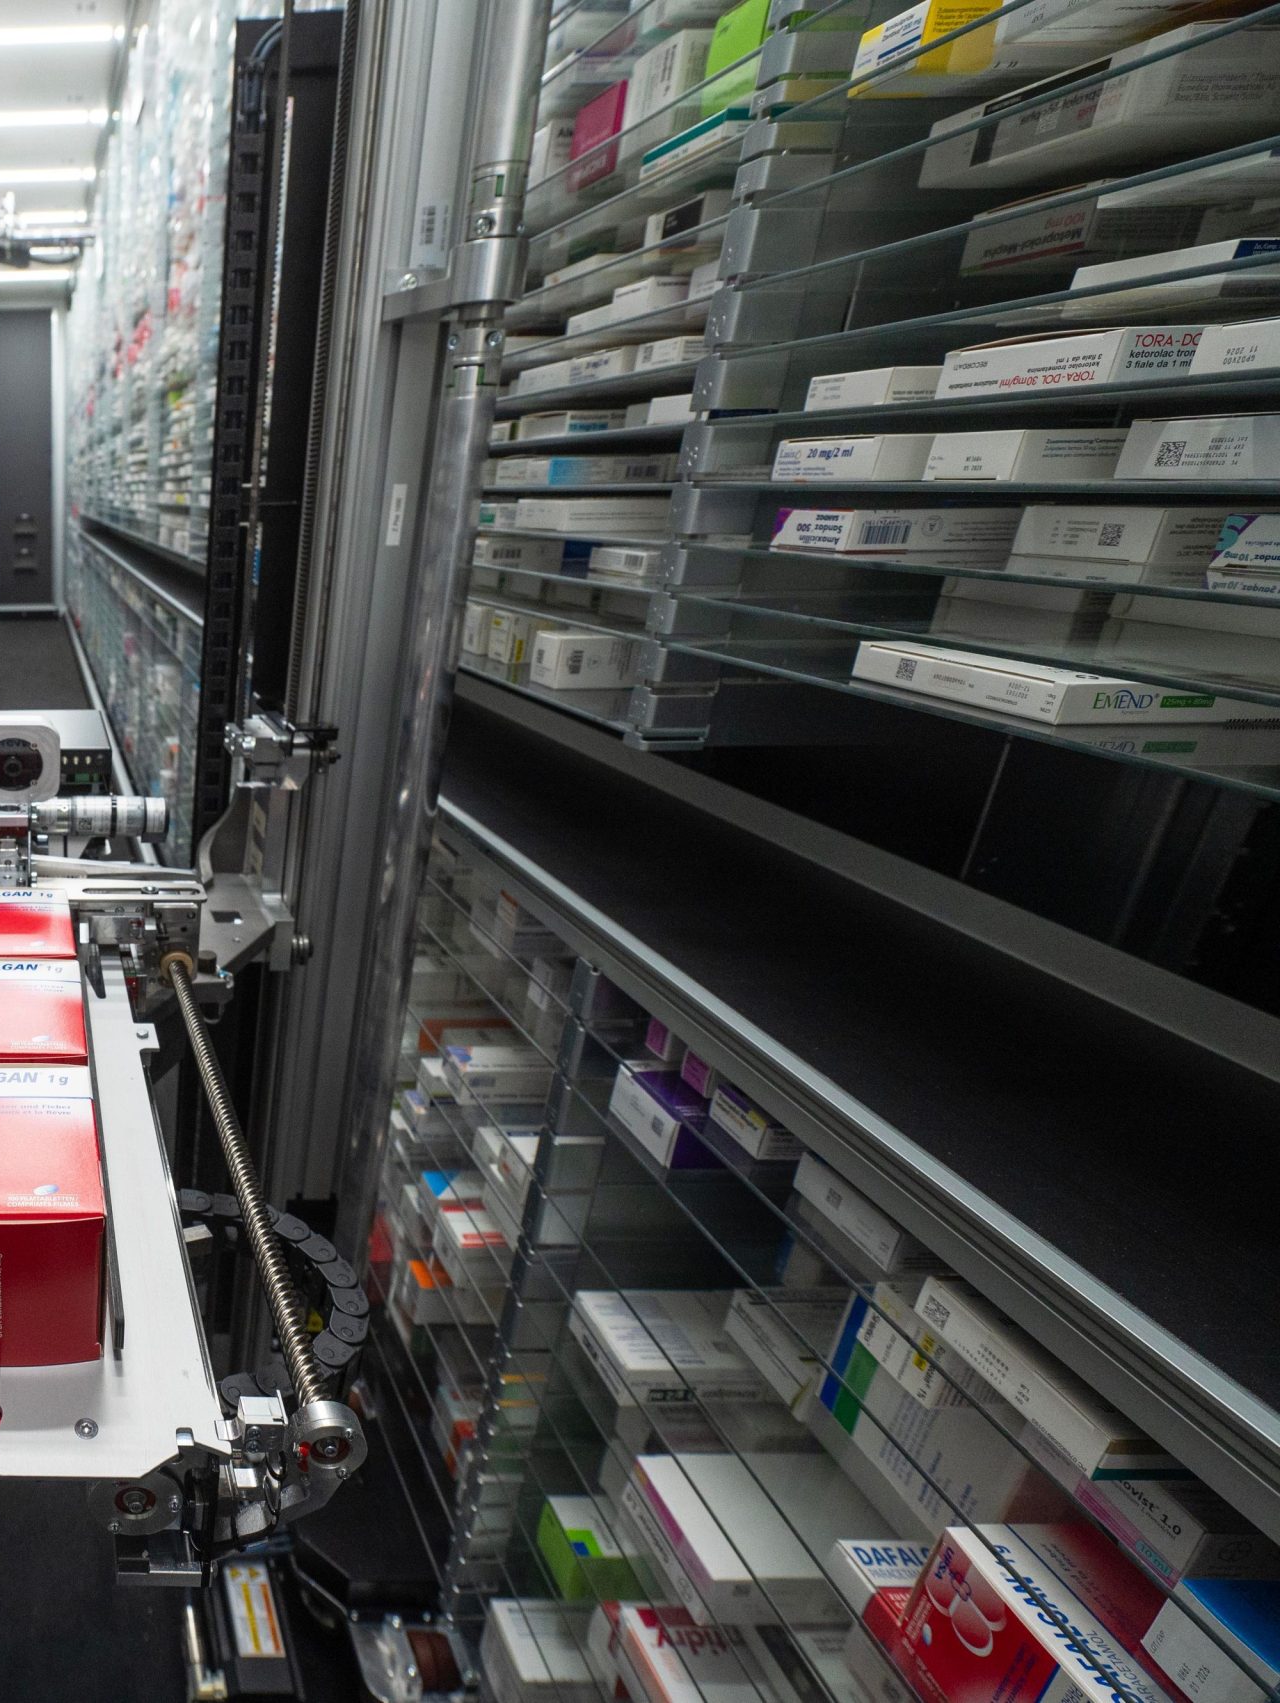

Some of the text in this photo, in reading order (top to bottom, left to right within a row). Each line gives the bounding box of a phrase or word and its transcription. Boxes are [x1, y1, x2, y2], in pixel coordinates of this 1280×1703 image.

[1130, 350, 1173, 358] ketorolac
[954, 361, 988, 371] RECORDATI
[1027, 361, 1100, 373] ketorolac trometamina
[1135, 360, 1169, 368] fiale da
[1000, 376, 1038, 389] 30mg/ml
[1042, 371, 1095, 384] TORA-DOL
[806, 446, 854, 461] 20 mg/2 ml
[797, 523, 810, 533] 500
[799, 534, 840, 545] Amoxicillin
[1223, 551, 1237, 560] mg
[59, 1075, 69, 1086] g
[1160, 1513, 1182, 1536] 1.0
[934, 1547, 955, 1580] UPSA
[1087, 1630, 1160, 1703] ARACETAMOL
